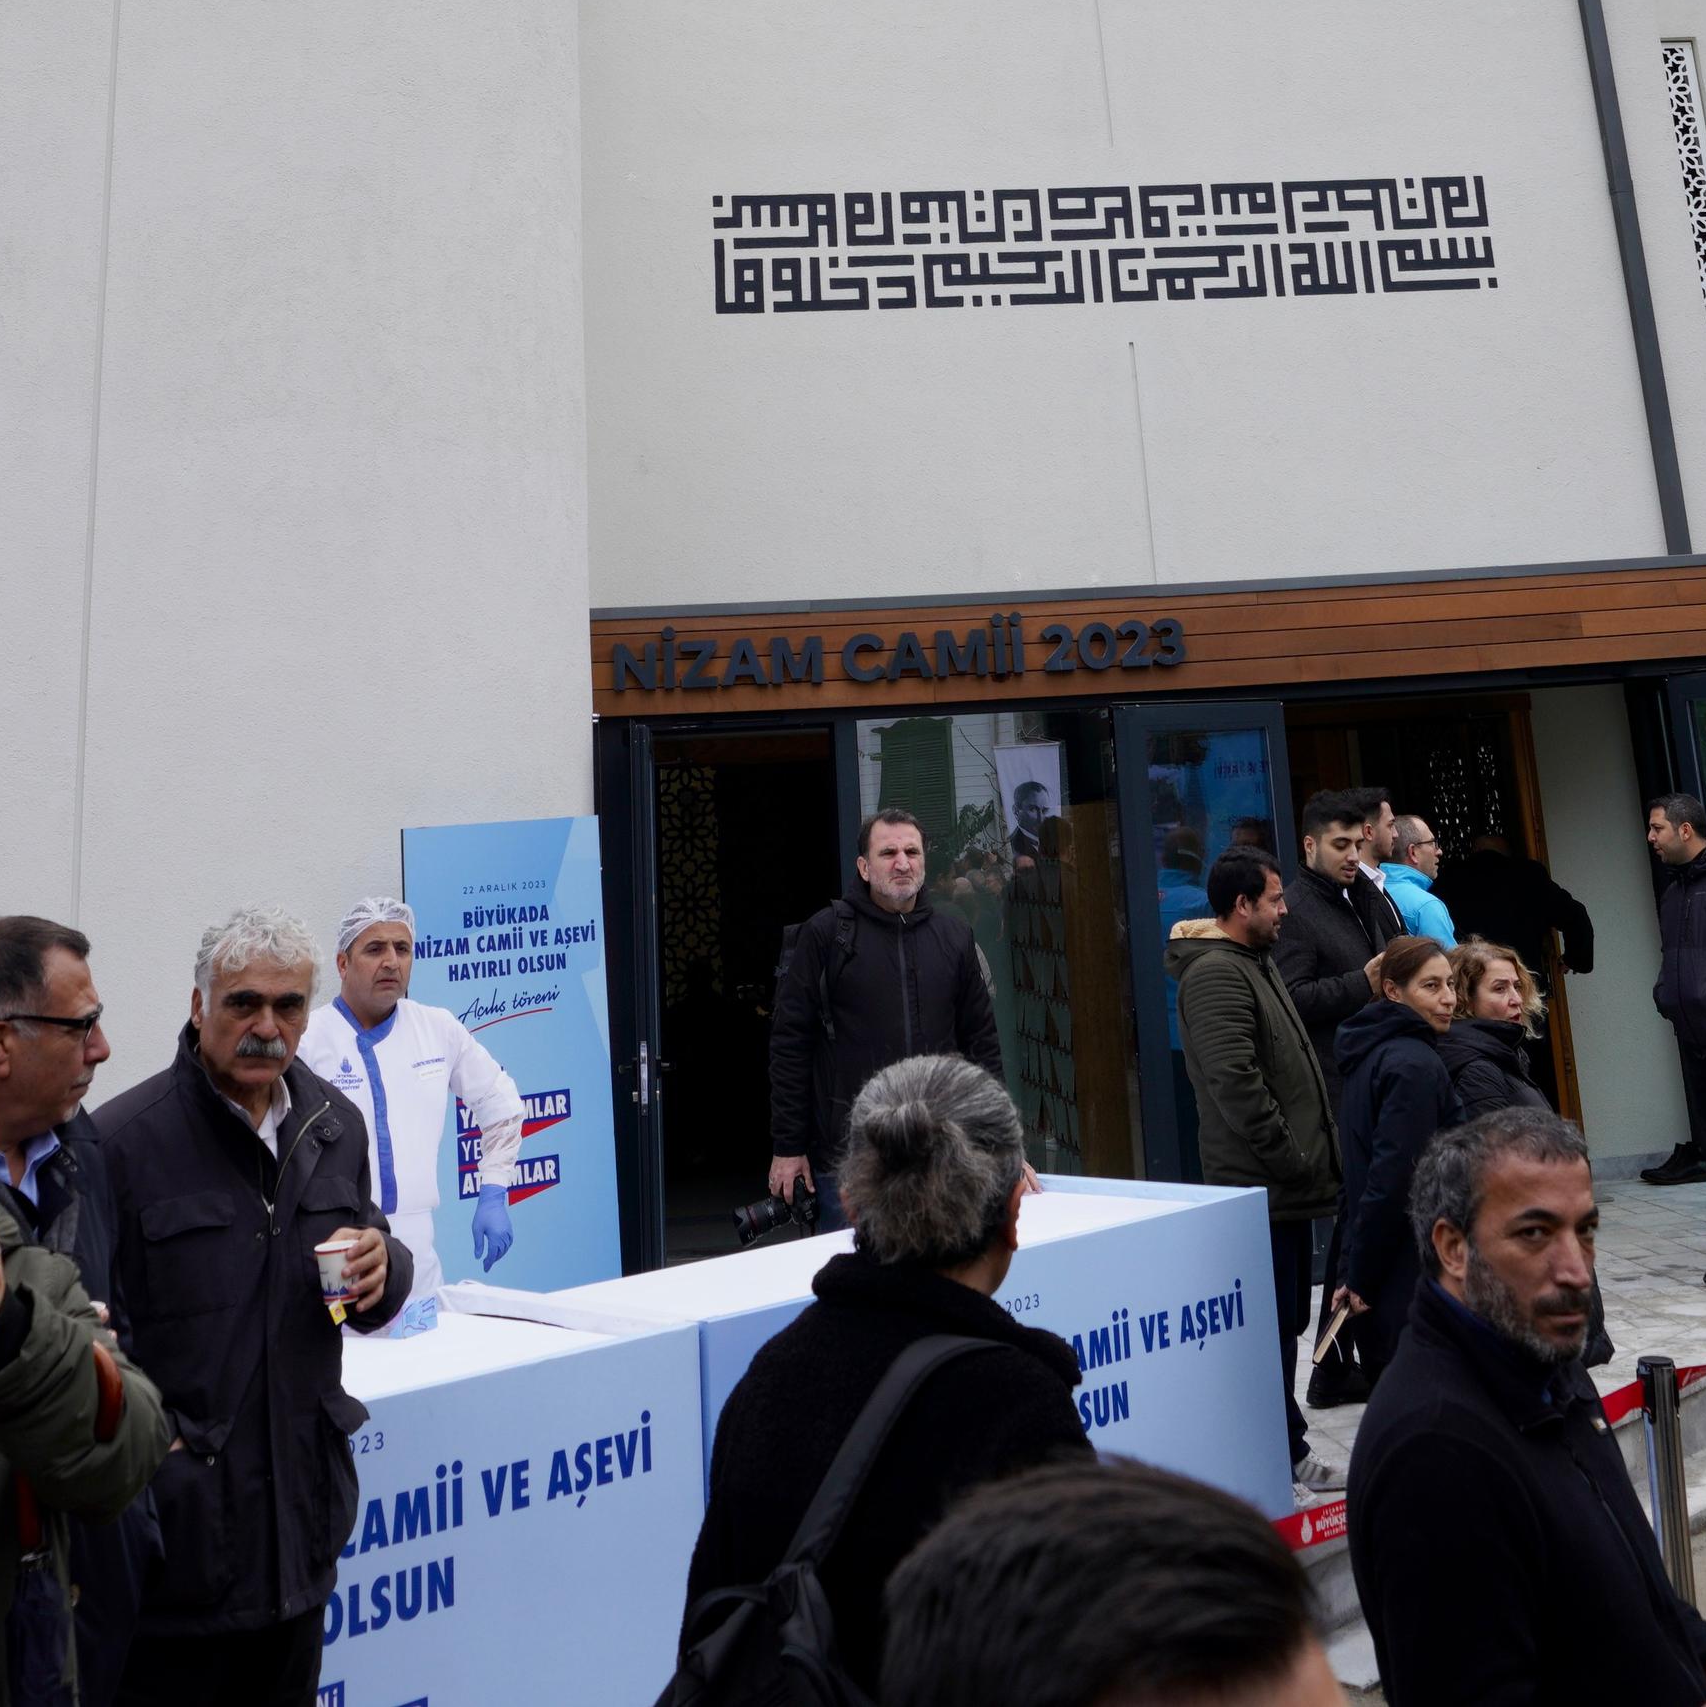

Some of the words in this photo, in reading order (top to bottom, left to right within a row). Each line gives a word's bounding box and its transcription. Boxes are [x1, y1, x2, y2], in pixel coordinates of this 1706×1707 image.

[612, 626, 824, 692] NİZAM
[841, 611, 1025, 682] CAMİİ
[1042, 617, 1186, 673] 2023
[463, 885, 476, 895] 22
[479, 881, 519, 893] ARALIK
[522, 879, 547, 890] 2023
[463, 903, 550, 929] BÜYÜKADA
[414, 934, 469, 960] NİZAM
[477, 927, 524, 953] CAMİİ
[530, 926, 548, 947] VE
[553, 919, 596, 950] AŞEVİ
[448, 958, 512, 982] HAYIRLI
[517, 952, 567, 975] OLSUN
[512, 983, 561, 1010] töreni
[459, 1094, 567, 1129] YAMLAR
[462, 1159, 556, 1195] ATMLAR
[1076, 1307, 1131, 1373] AMİİ
[1140, 1310, 1171, 1354] VE
[1180, 1278, 1245, 1352] AŞEVİ
[1079, 1381, 1130, 1433] SUN
[340, 1459, 464, 1560] AMİİ
[481, 1459, 531, 1518] VE
[547, 1409, 652, 1509] AŞEVİ
[322, 1556, 455, 1647] OLSUN
